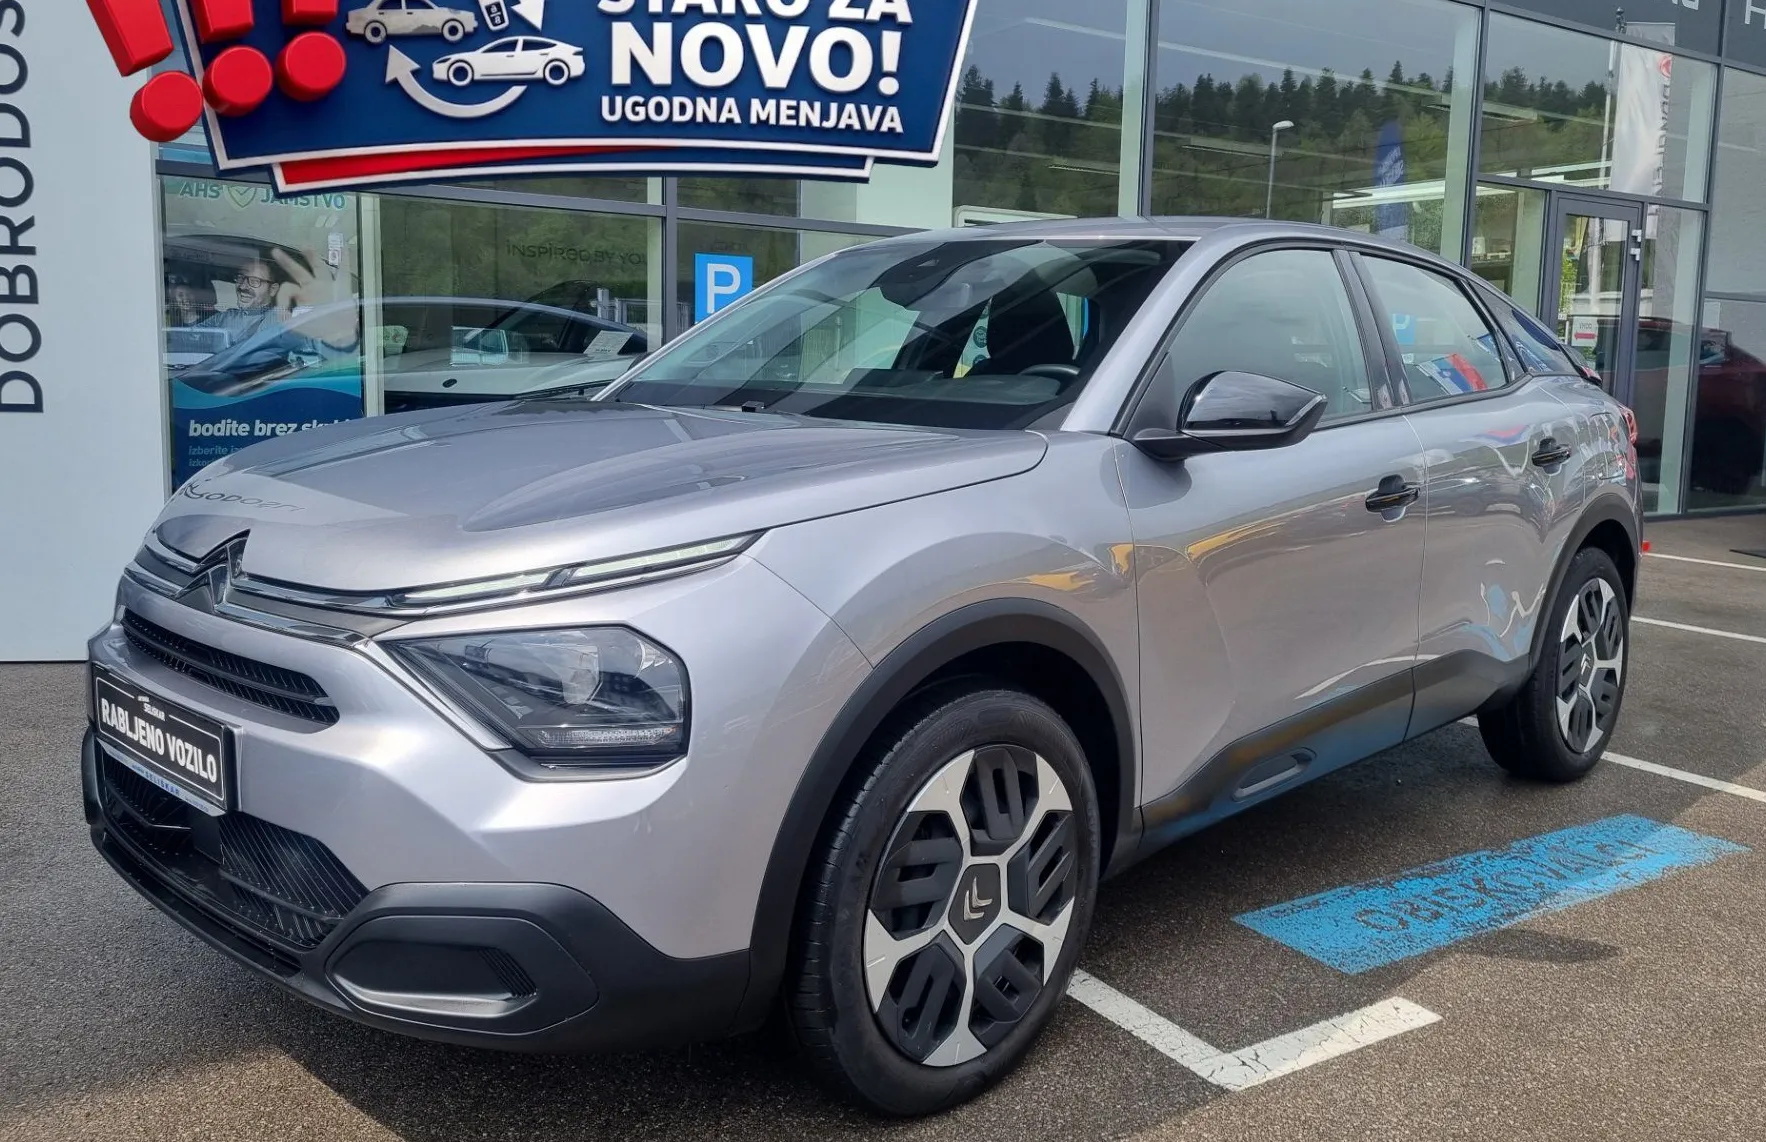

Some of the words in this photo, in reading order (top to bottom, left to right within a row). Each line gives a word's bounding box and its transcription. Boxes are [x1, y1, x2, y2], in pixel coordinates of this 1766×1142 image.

[179, 182, 222, 198] AHS
[707, 263, 741, 313] P
[188, 419, 250, 437] bodite
[254, 419, 298, 436] brez
[101, 698, 165, 756] RABLJENO
[166, 733, 217, 783] VOZILO
